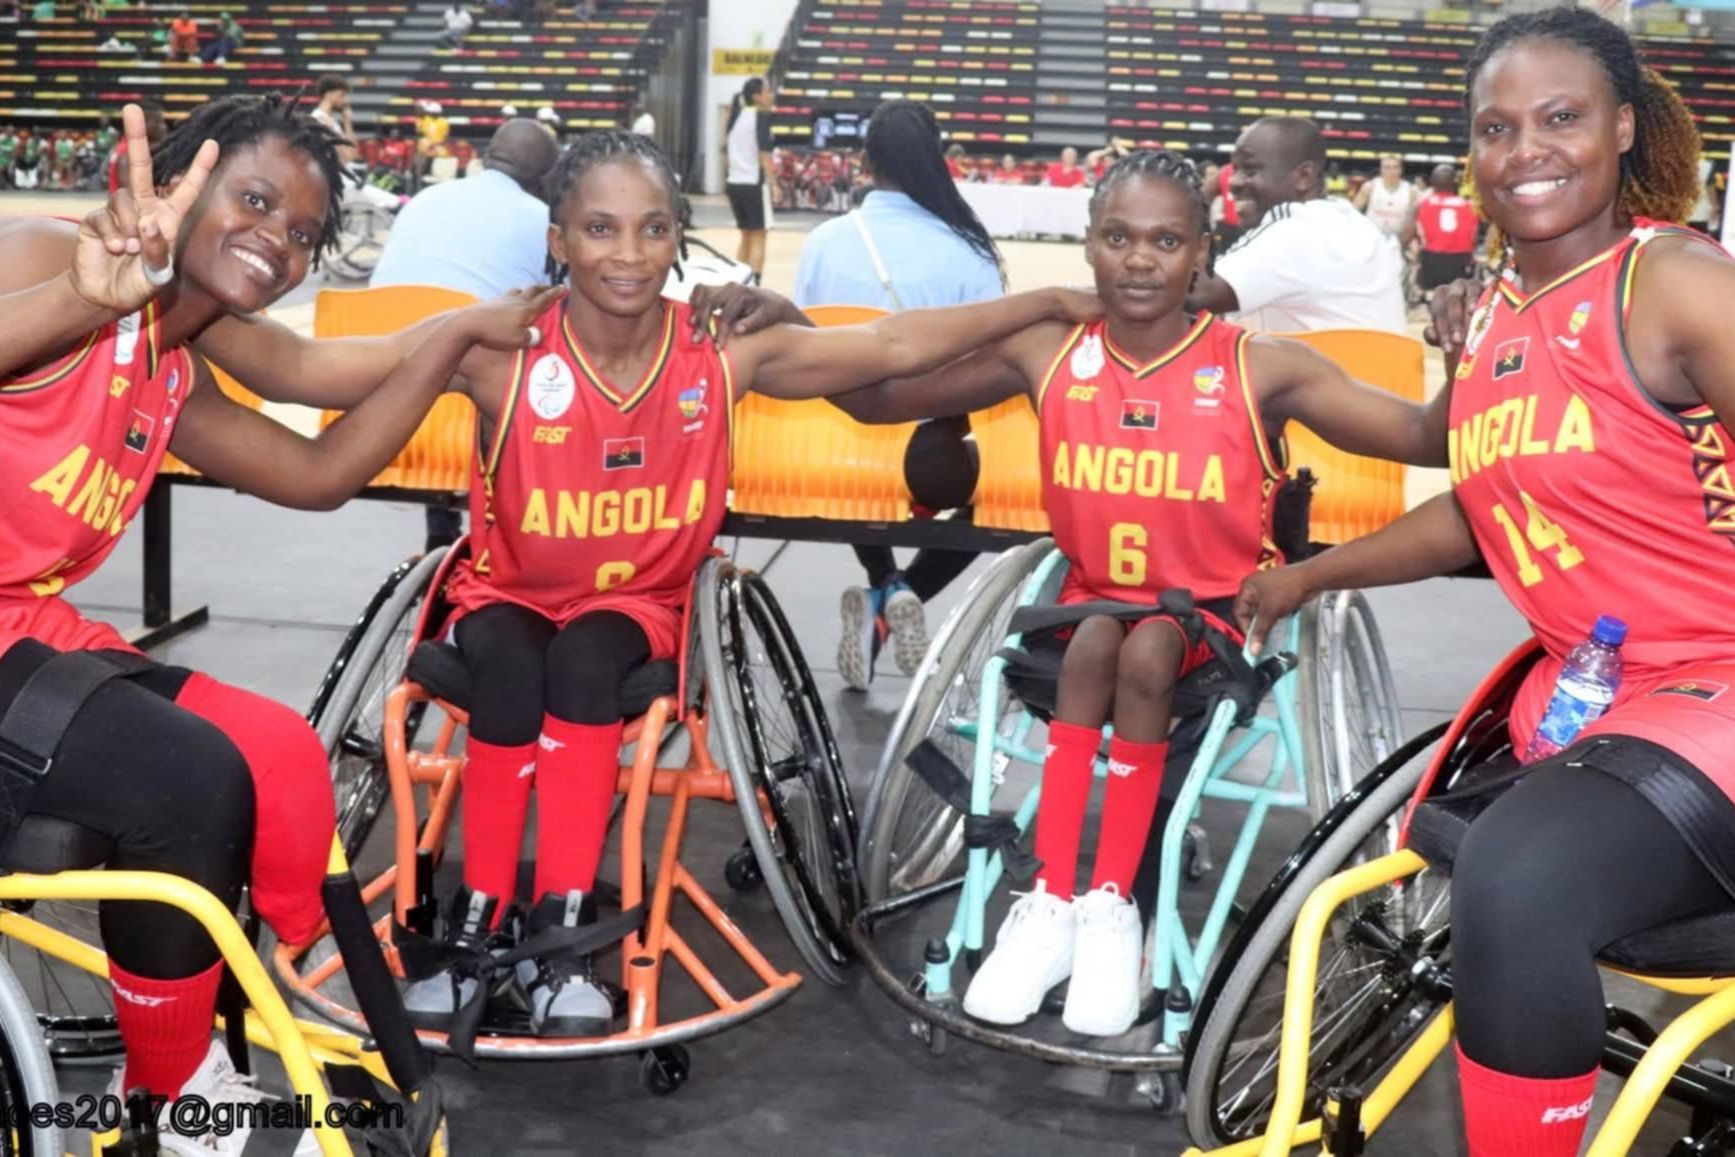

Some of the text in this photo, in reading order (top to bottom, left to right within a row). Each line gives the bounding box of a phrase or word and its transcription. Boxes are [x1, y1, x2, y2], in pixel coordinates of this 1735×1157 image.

[1053, 440, 1226, 503] ANGOLA
[520, 479, 706, 538] ANGOLA
[1492, 490, 1585, 588] 14
[1109, 522, 1147, 587] 6
[1541, 1095, 1594, 1124] FAS
